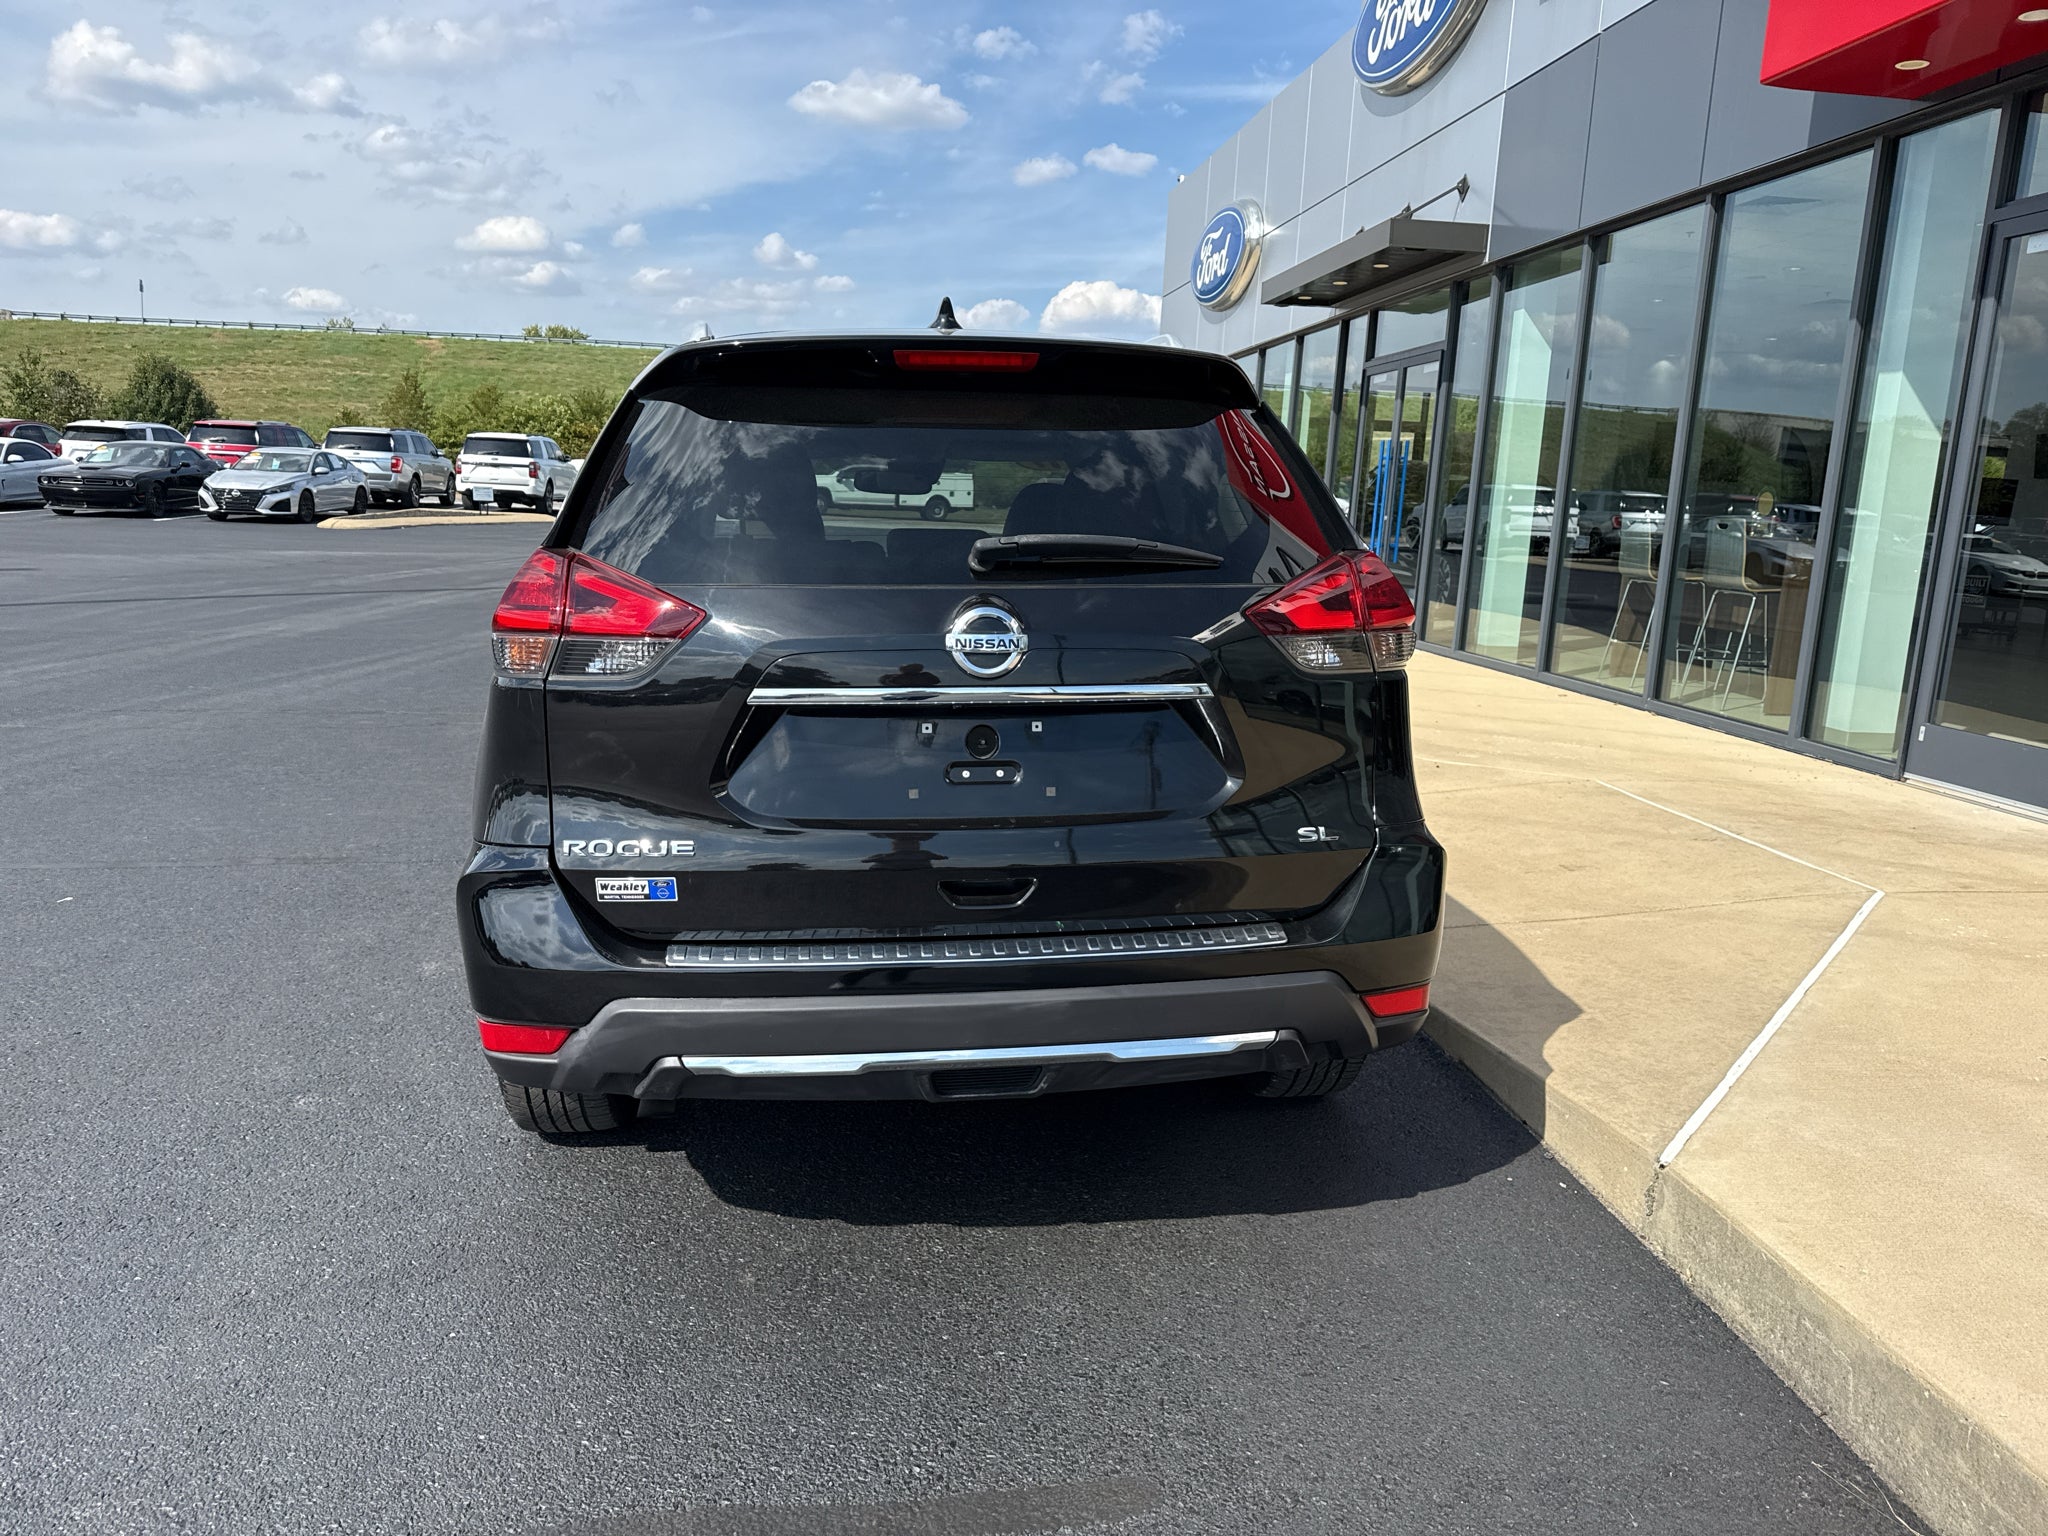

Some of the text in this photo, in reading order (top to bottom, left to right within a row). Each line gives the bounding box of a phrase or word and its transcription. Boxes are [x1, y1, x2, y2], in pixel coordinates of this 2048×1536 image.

[1197, 226, 1232, 289] Ford
[955, 638, 1020, 649] NISSAN
[1297, 826, 1340, 842] SL
[562, 839, 695, 857] ROGUE
[599, 883, 647, 893] Weakley
